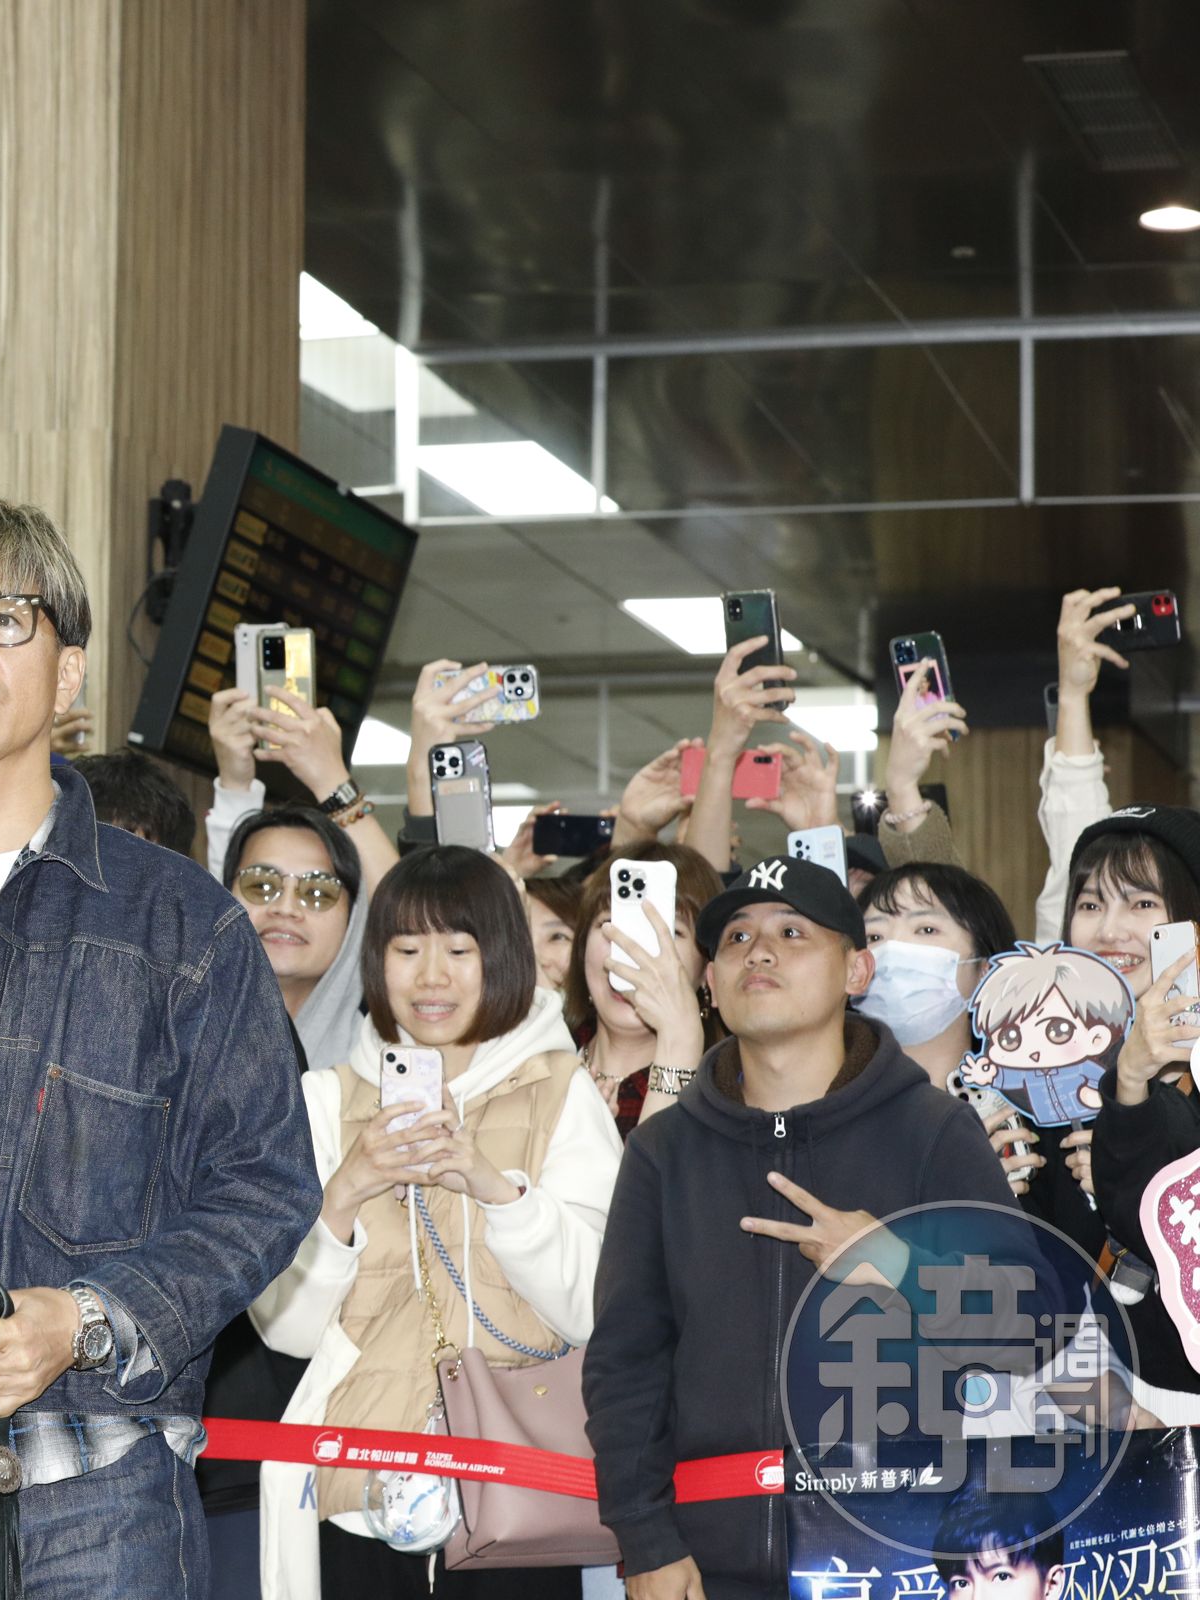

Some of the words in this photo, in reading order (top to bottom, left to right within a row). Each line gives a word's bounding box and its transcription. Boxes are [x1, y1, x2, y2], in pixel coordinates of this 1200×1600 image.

[748, 859, 788, 891] NY
[426, 1451, 454, 1461] TAIPEI
[424, 1459, 467, 1471] SONGSHAN
[467, 1464, 506, 1475] AIRPORT
[794, 1471, 858, 1494] Simply
[860, 1468, 917, 1489] 新普利
